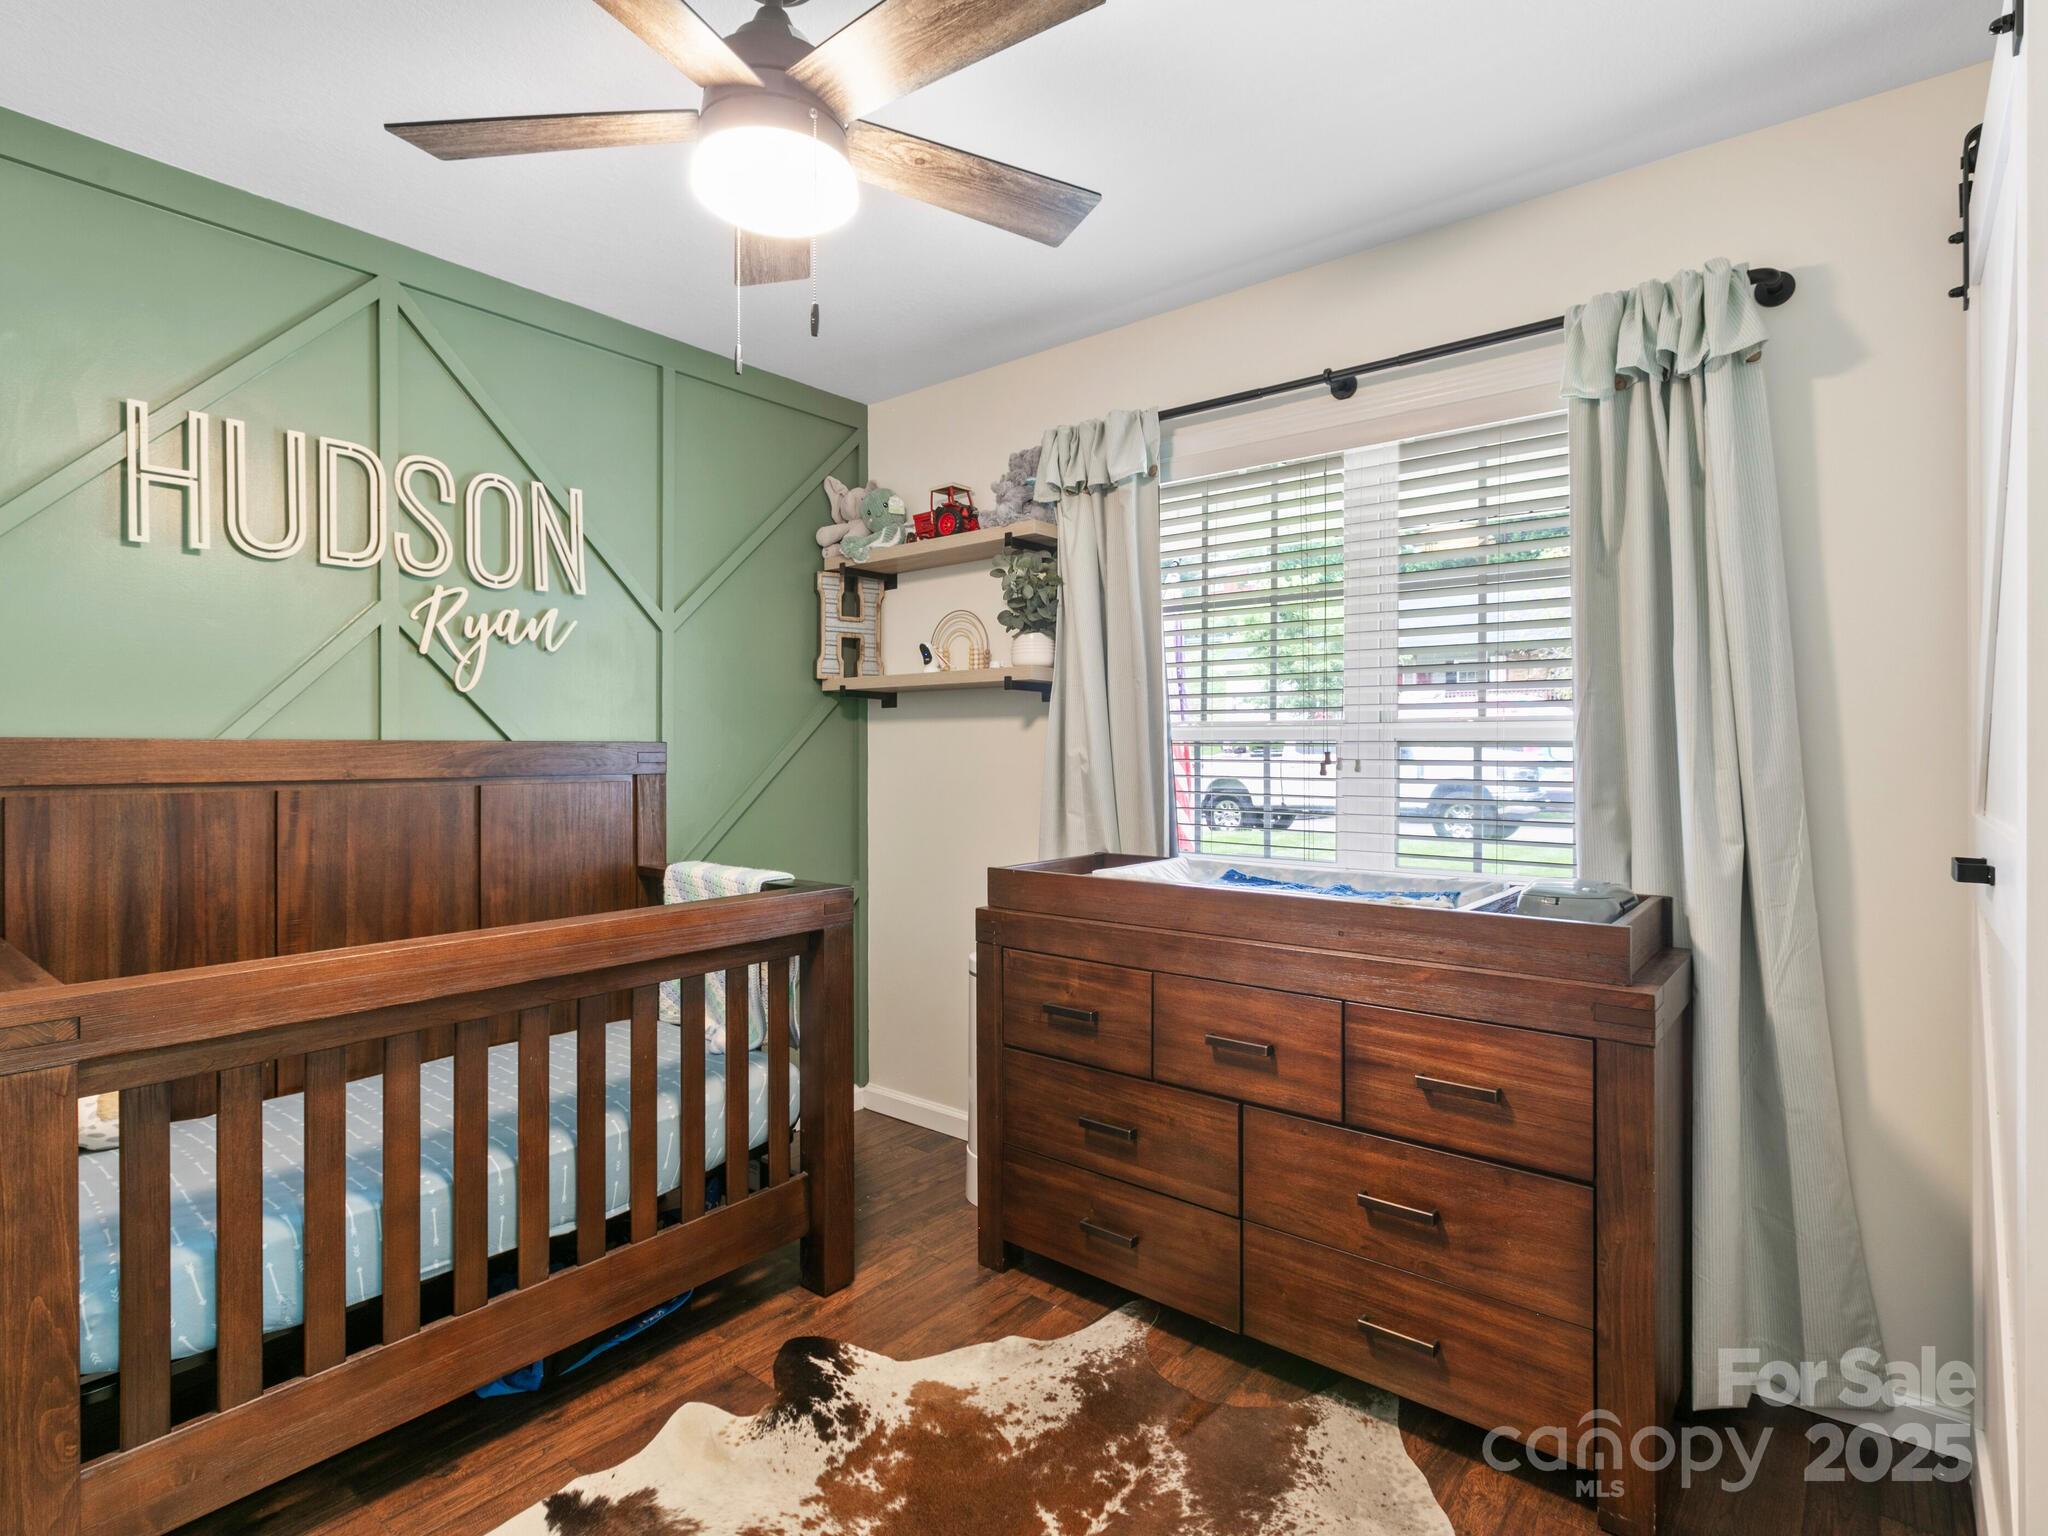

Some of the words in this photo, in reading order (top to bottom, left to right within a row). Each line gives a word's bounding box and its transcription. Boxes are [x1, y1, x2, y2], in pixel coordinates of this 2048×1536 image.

[126, 398, 587, 596] HUDSON
[410, 584, 578, 693] Ryan
[816, 571, 885, 680] H
